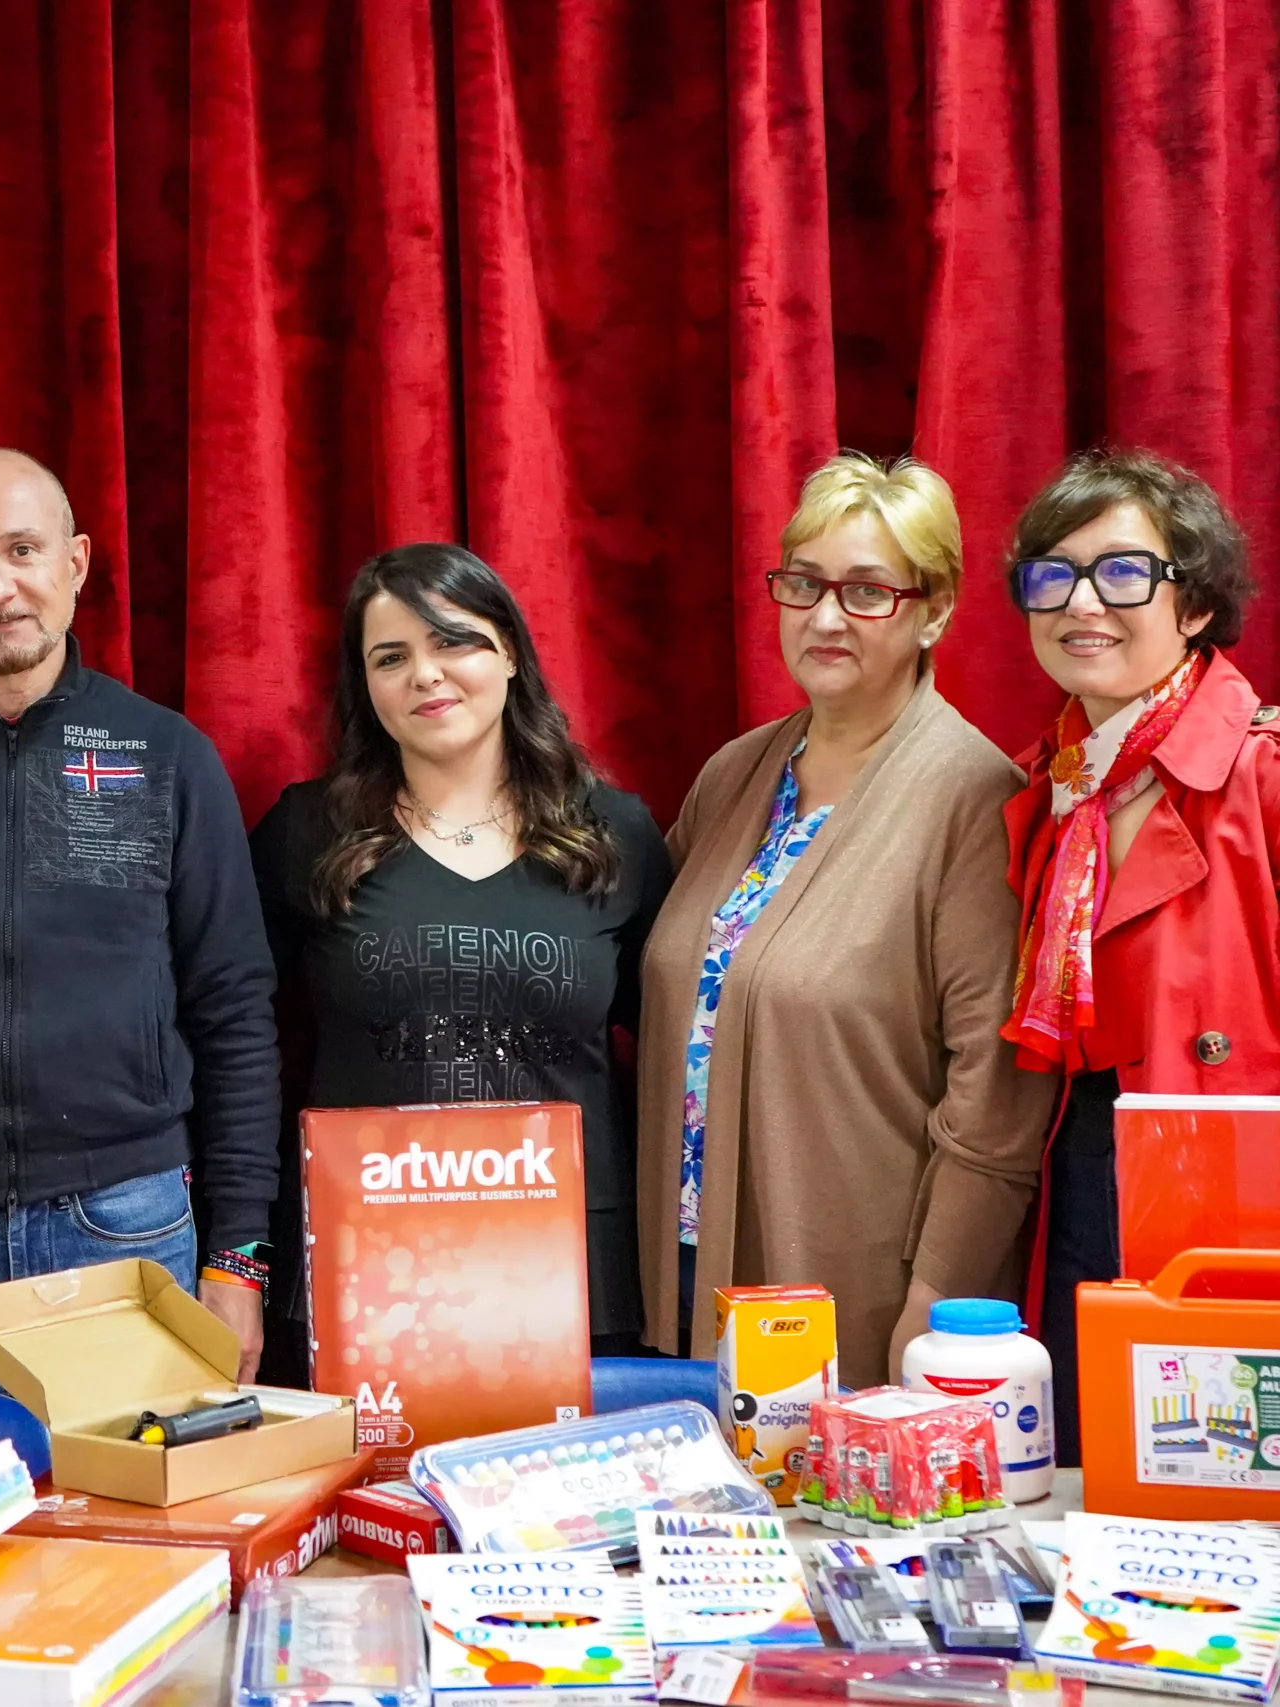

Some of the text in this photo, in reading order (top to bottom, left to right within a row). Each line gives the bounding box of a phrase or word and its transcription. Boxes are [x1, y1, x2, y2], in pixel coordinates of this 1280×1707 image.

[64, 725, 109, 739] ICELAND
[64, 736, 148, 750] PEACEKEEPERS
[361, 1138, 556, 1190] artwork
[363, 1188, 558, 1204] PREMIUM MULTIPURPOSE BUSINESS PAPER
[356, 1381, 402, 1414] A4
[759, 1413, 810, 1430] Origin
[358, 1428, 385, 1444] 500
[342, 1514, 404, 1549] STABILO
[448, 1561, 574, 1574] GIOTTO
[670, 1561, 775, 1570] GIOTTO
[1120, 1561, 1258, 1586] GIOTTO
[471, 1584, 603, 1598] GIOTTO
[669, 1589, 776, 1599] GIOTTO
